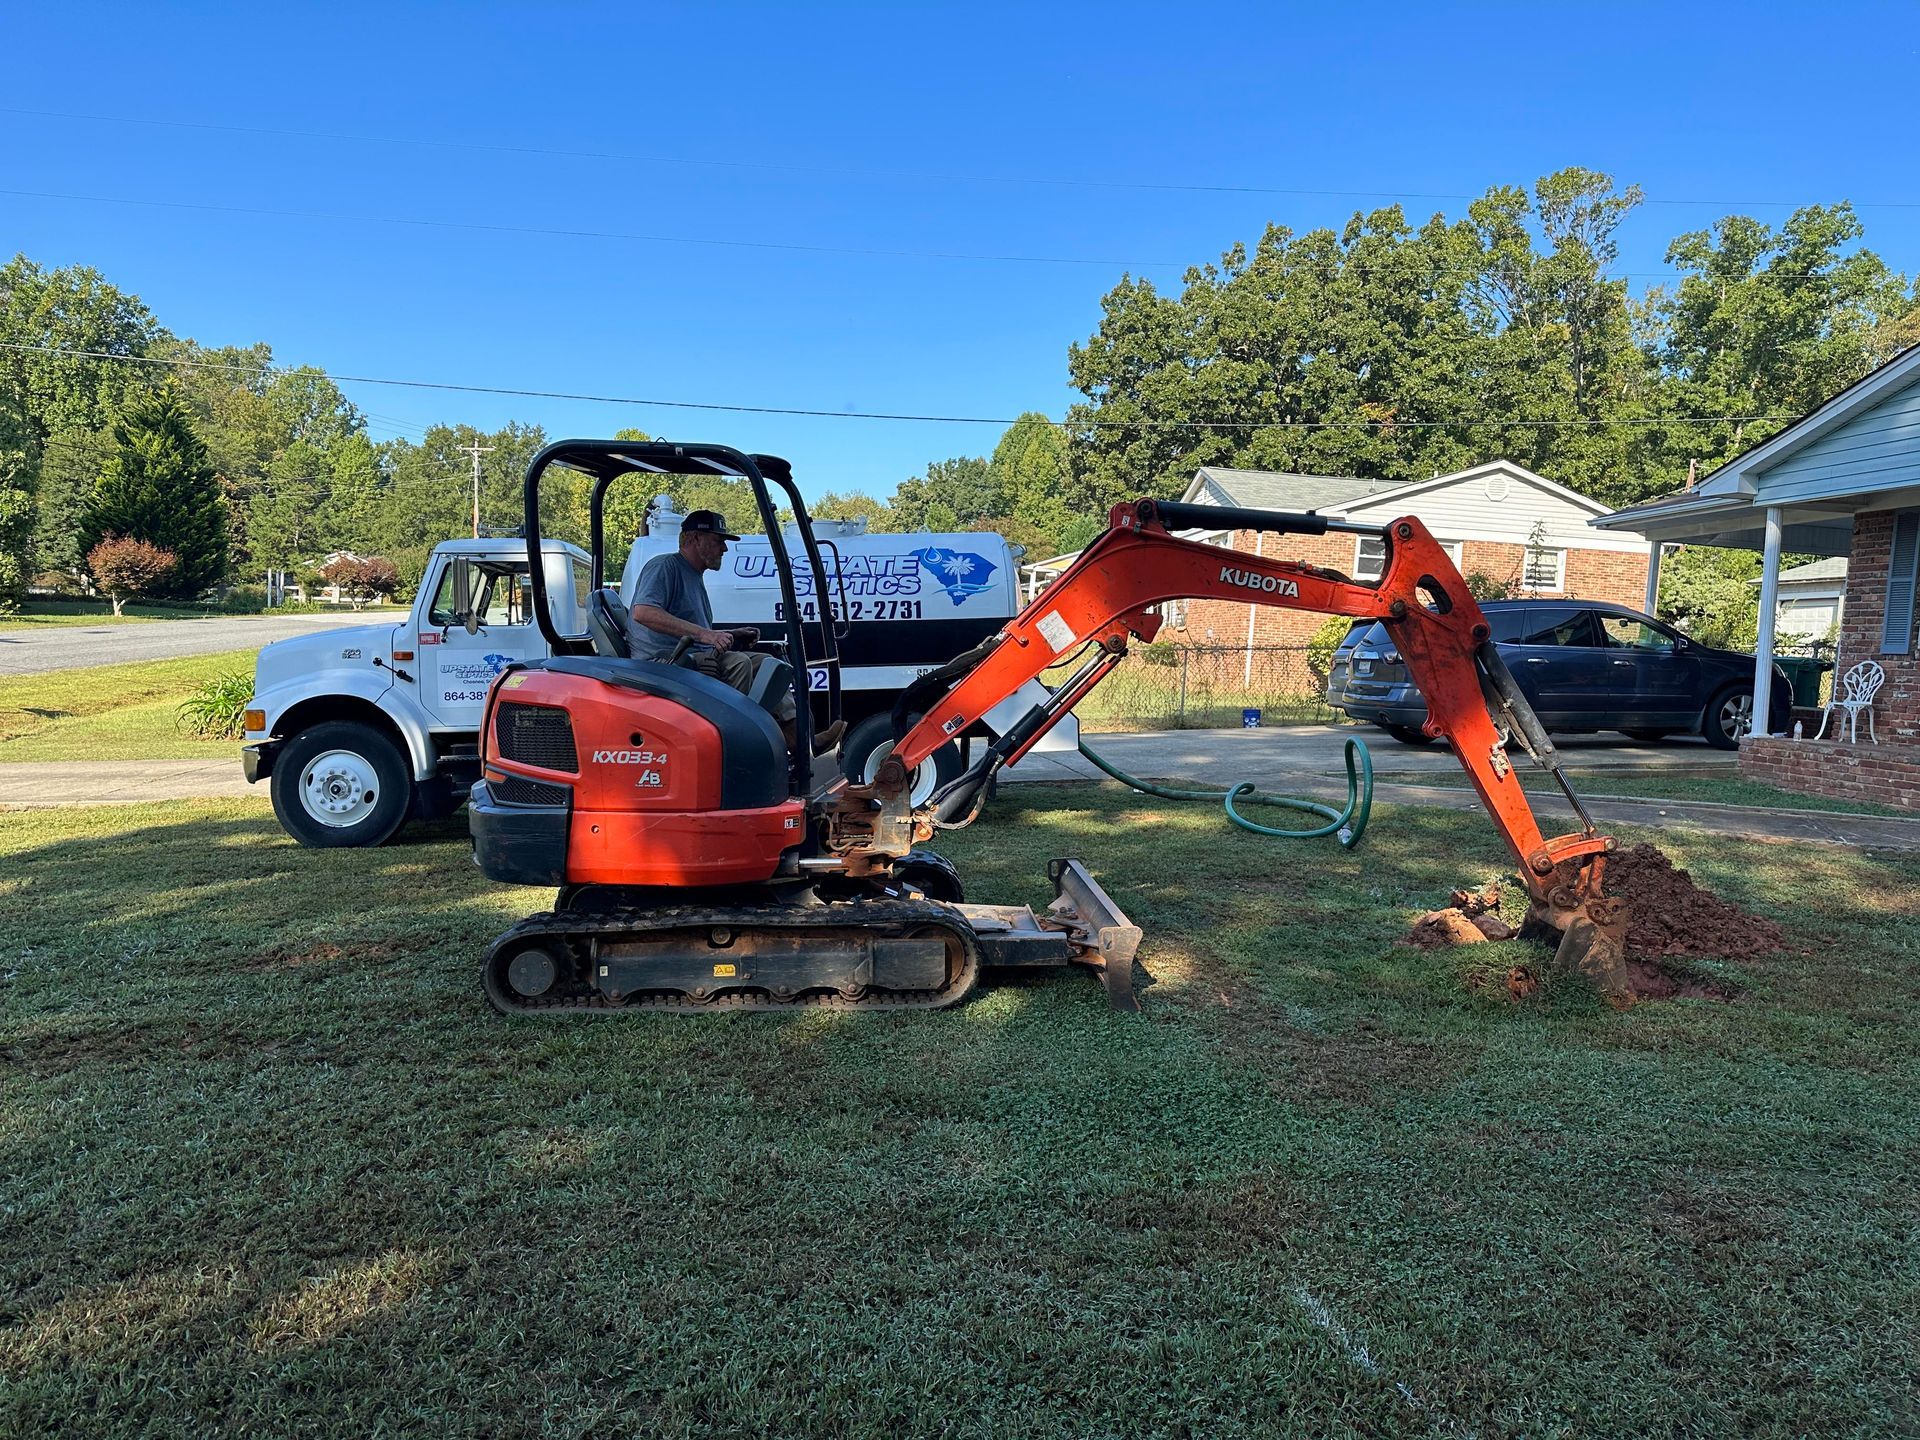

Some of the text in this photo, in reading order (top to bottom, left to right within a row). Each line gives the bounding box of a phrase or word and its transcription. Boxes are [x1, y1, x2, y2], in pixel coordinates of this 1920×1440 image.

[734, 555, 920, 578] UPSTATE
[1219, 567, 1299, 598] KUBOTA
[775, 600, 922, 621] 84-62-2731
[440, 664, 495, 674] UPSTATE
[807, 669, 828, 690] 2
[592, 751, 667, 764] KX033-4
